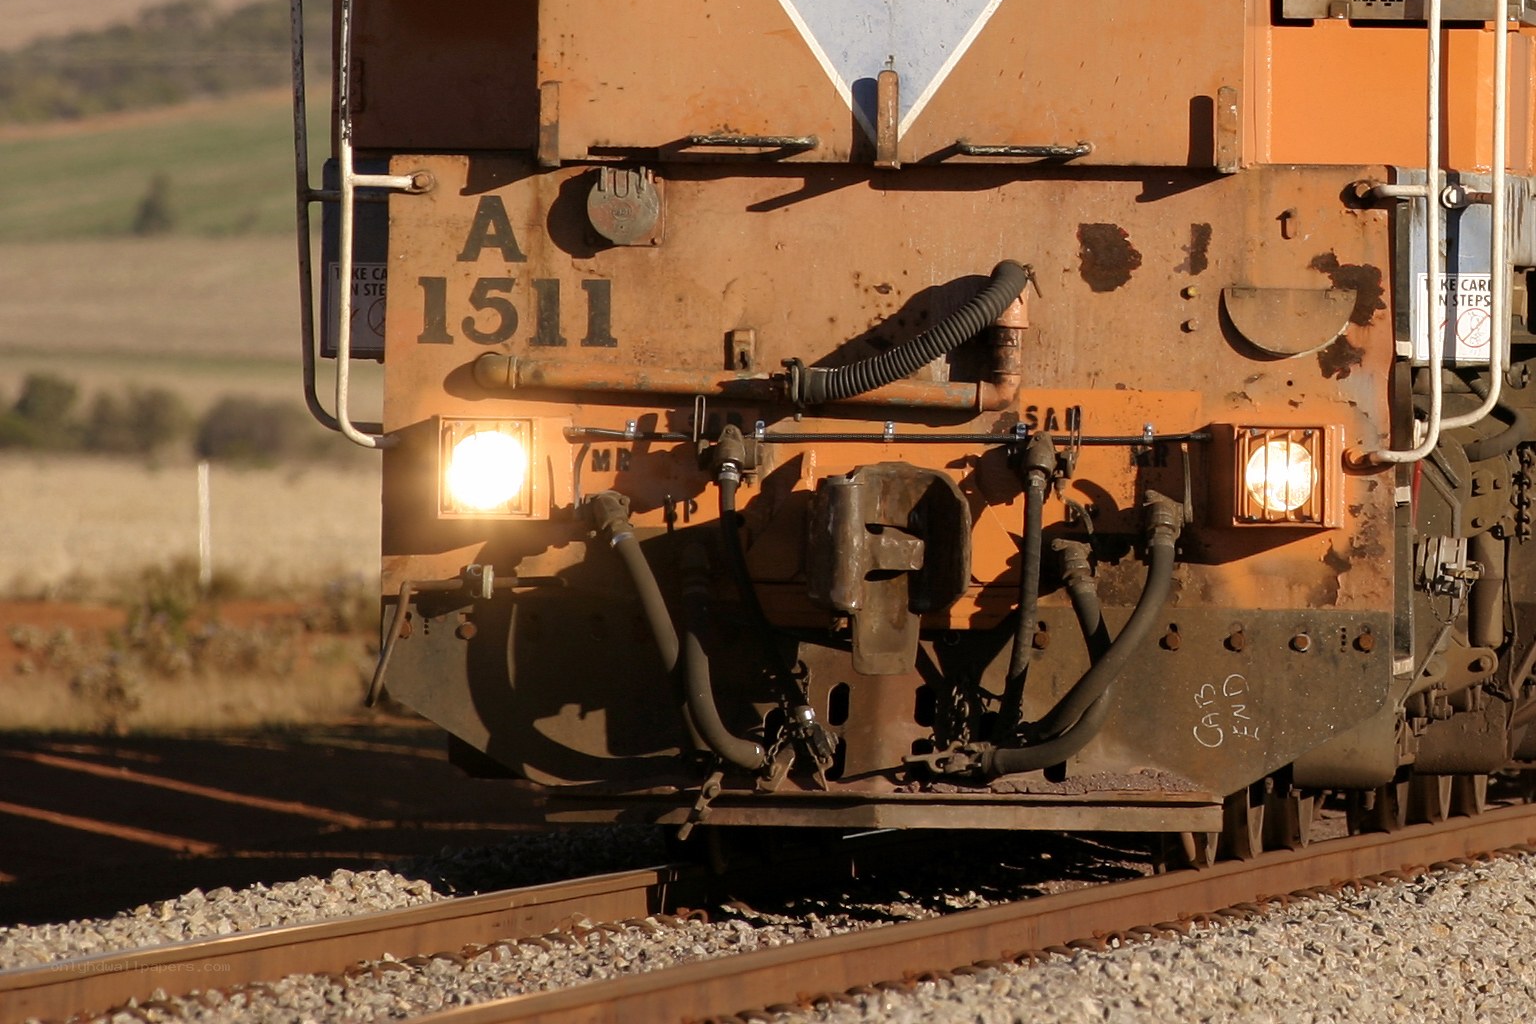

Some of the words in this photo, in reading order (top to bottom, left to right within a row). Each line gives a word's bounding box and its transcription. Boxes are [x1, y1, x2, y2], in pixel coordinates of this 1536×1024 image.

[456, 195, 527, 263] A
[335, 267, 367, 280] TKE
[372, 267, 388, 280] CA
[364, 283, 386, 296] STE
[1424, 278, 1456, 291] TKE
[1453, 294, 1491, 307] STEPS
[416, 276, 618, 348] 1511
[591, 447, 632, 472] MR
[1193, 683, 1223, 748] CAB
